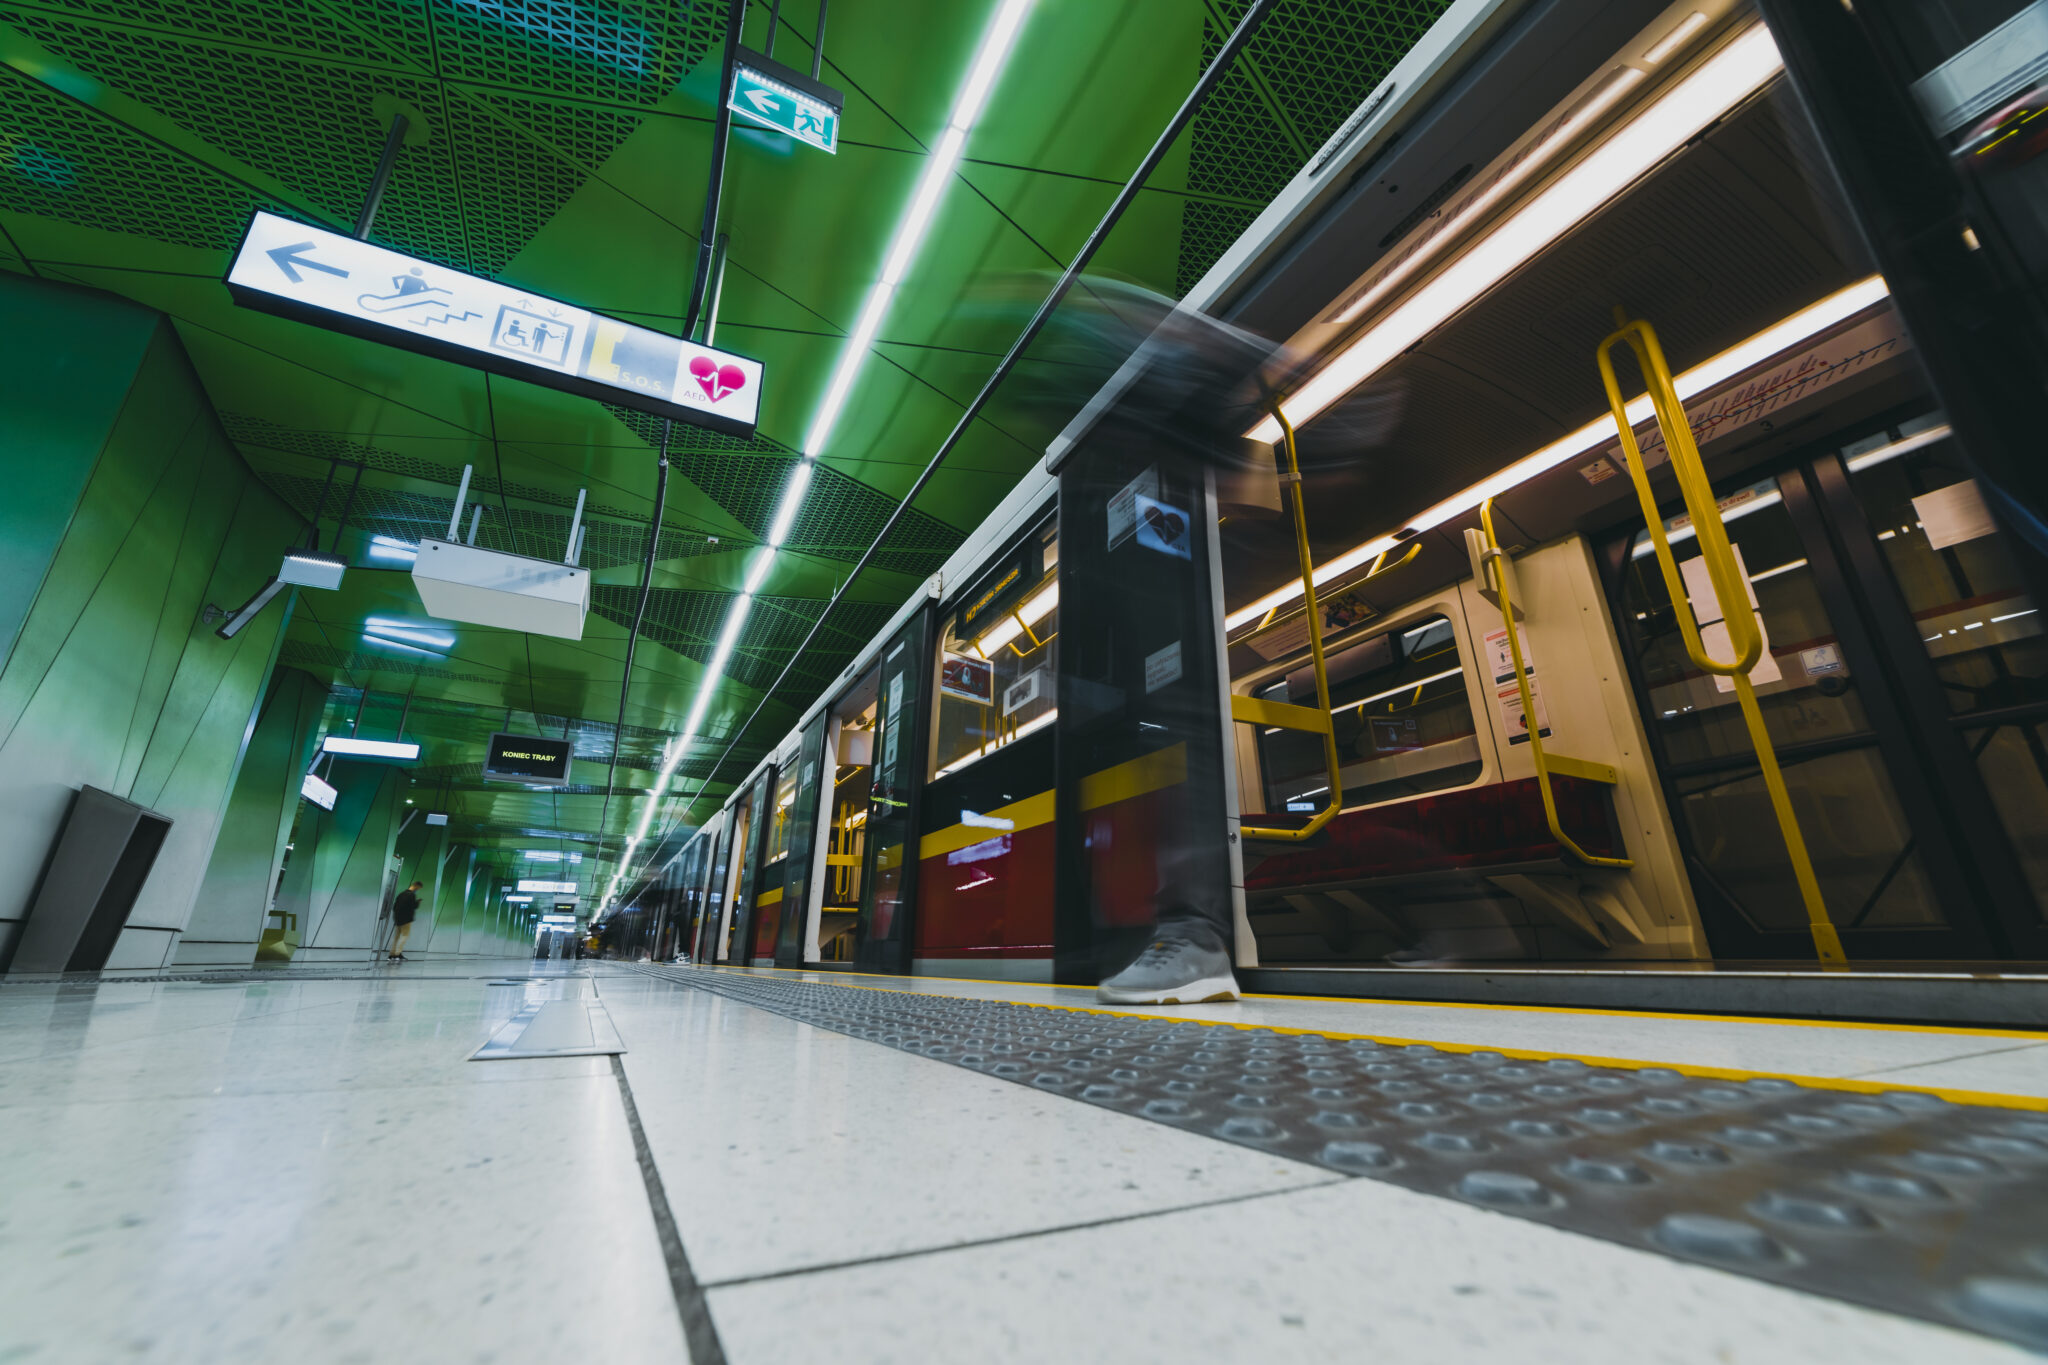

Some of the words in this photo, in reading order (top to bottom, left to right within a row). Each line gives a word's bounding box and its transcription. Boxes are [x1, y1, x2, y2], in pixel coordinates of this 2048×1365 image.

[622, 371, 665, 392] S.O.S.
[684, 390, 706, 401] AED
[502, 751, 530, 759] KONIEC
[532, 753, 556, 761] TRASY
